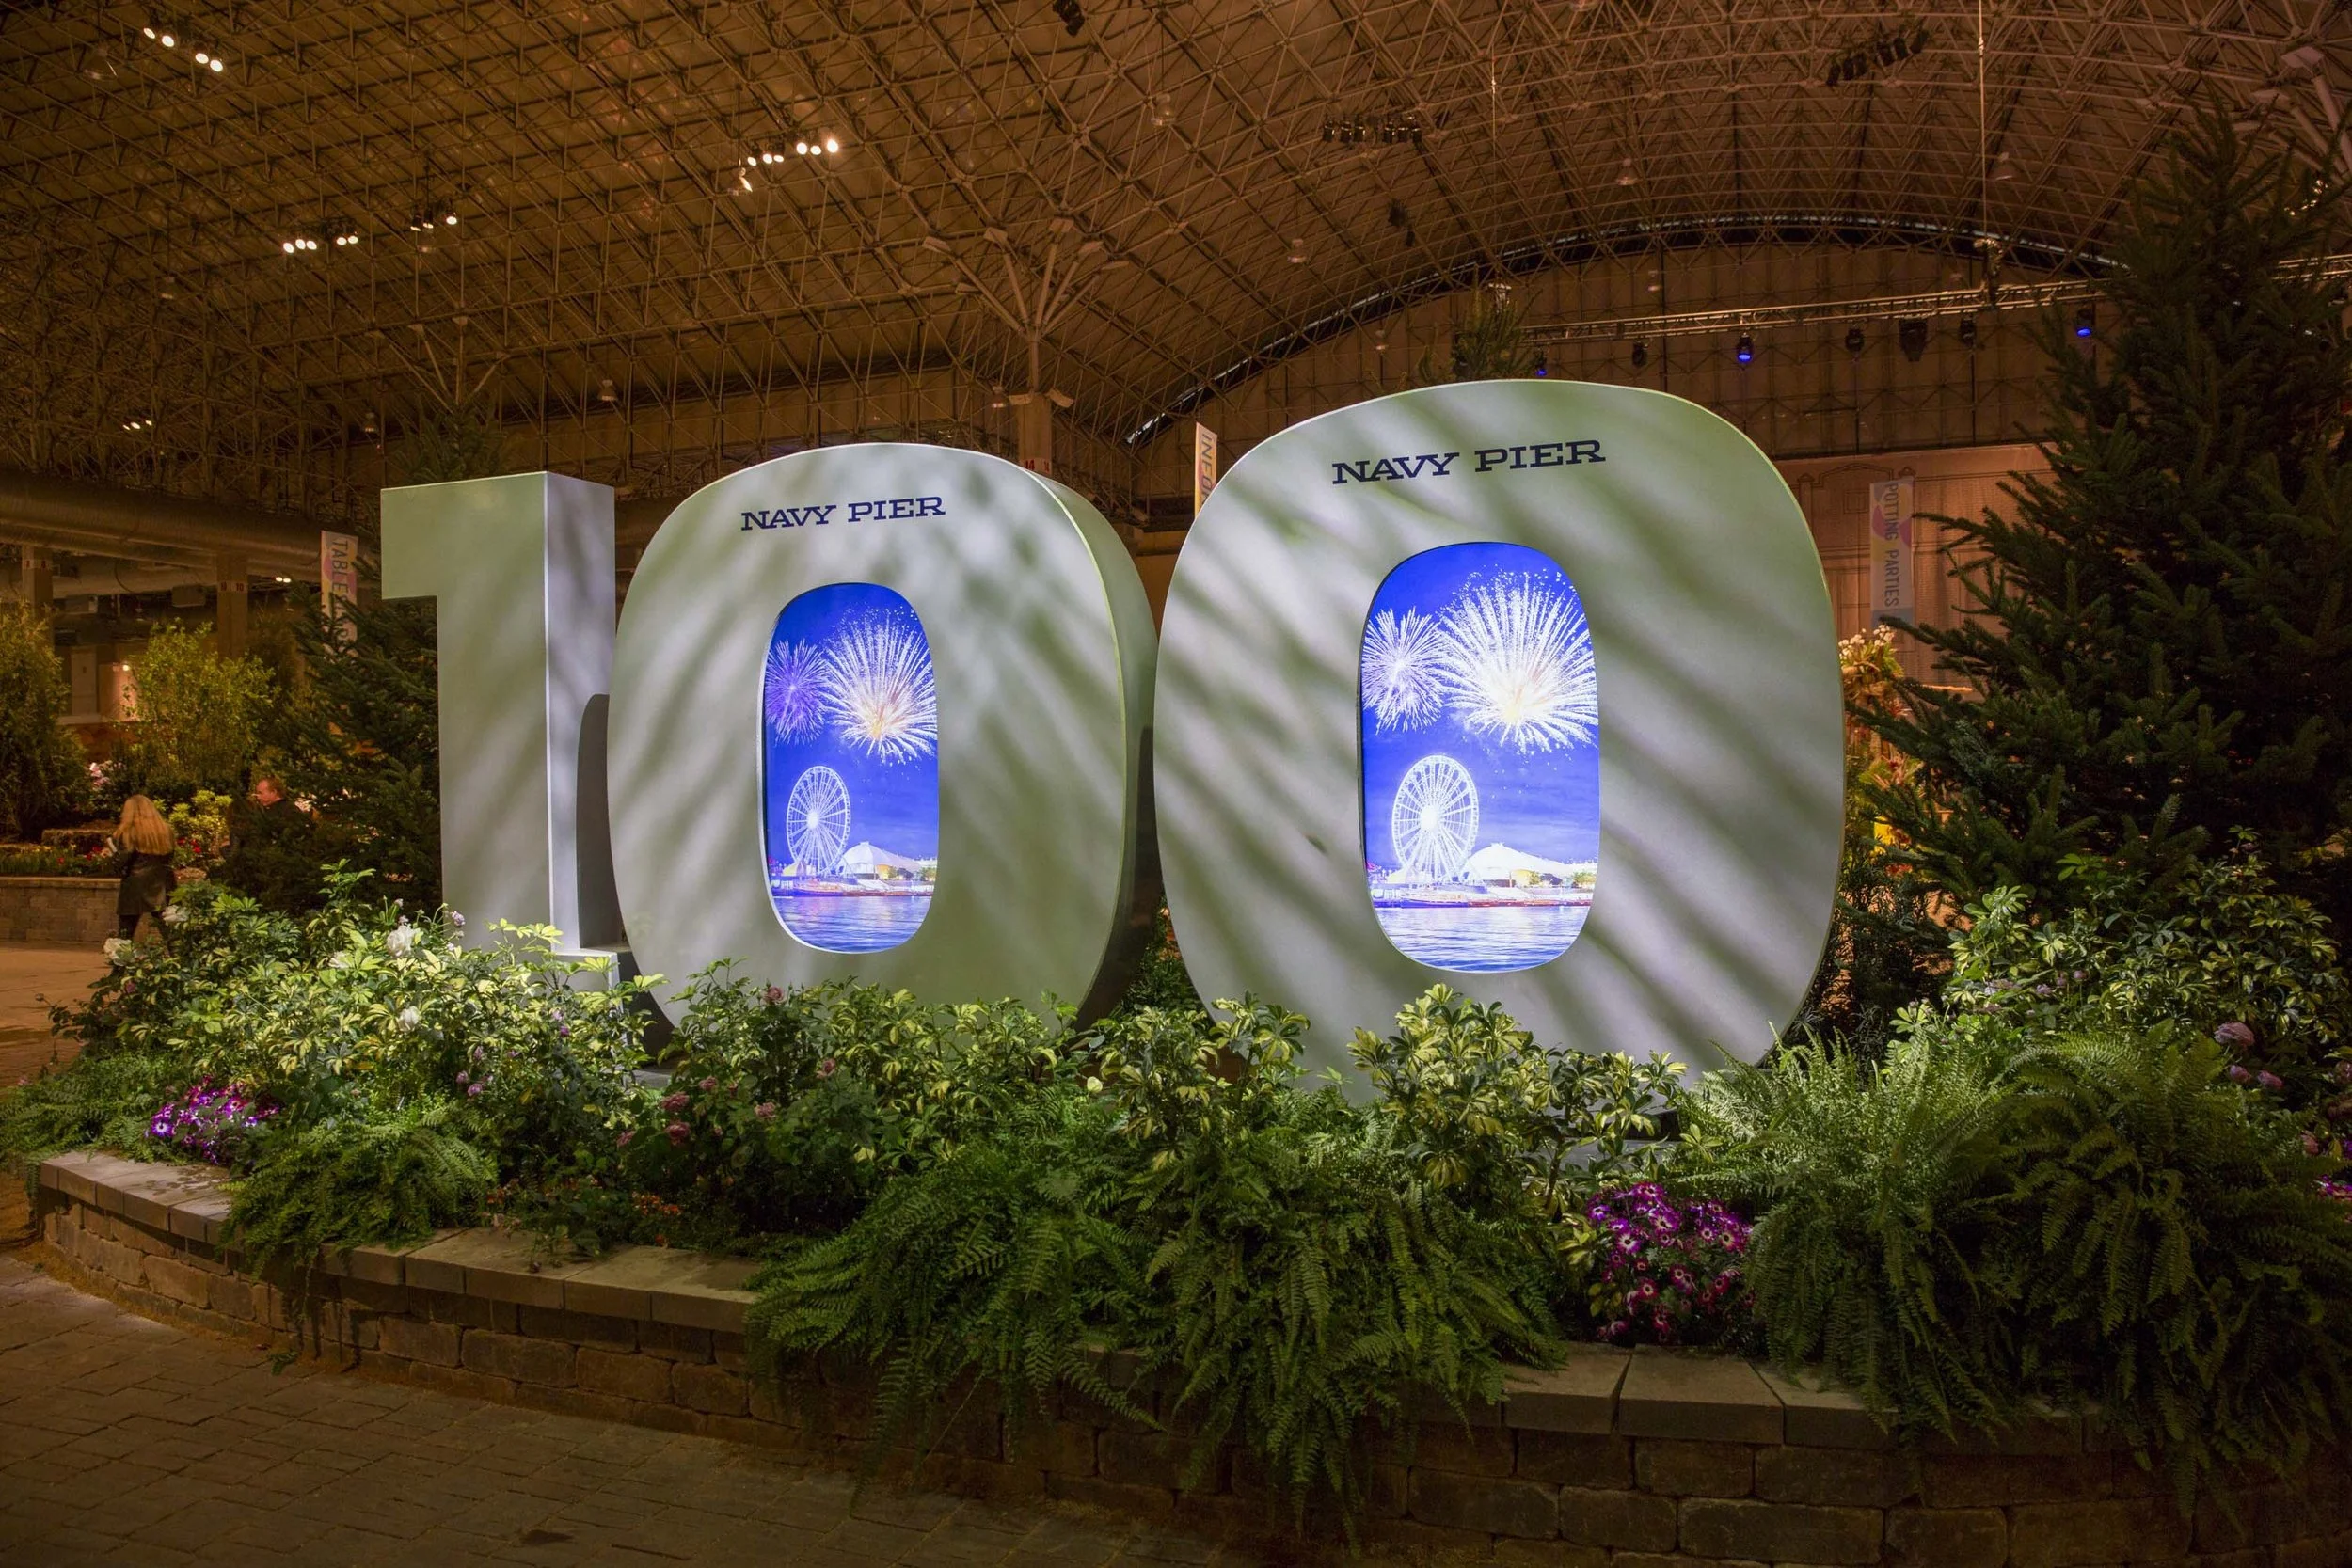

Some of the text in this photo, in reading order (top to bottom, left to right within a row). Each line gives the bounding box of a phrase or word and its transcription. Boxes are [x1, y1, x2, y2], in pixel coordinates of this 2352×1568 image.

[1332, 440, 1606, 484] NAVY PIER
[741, 496, 946, 531] NAVY PIER
[1883, 483, 1900, 608] POTTING PARTIES
